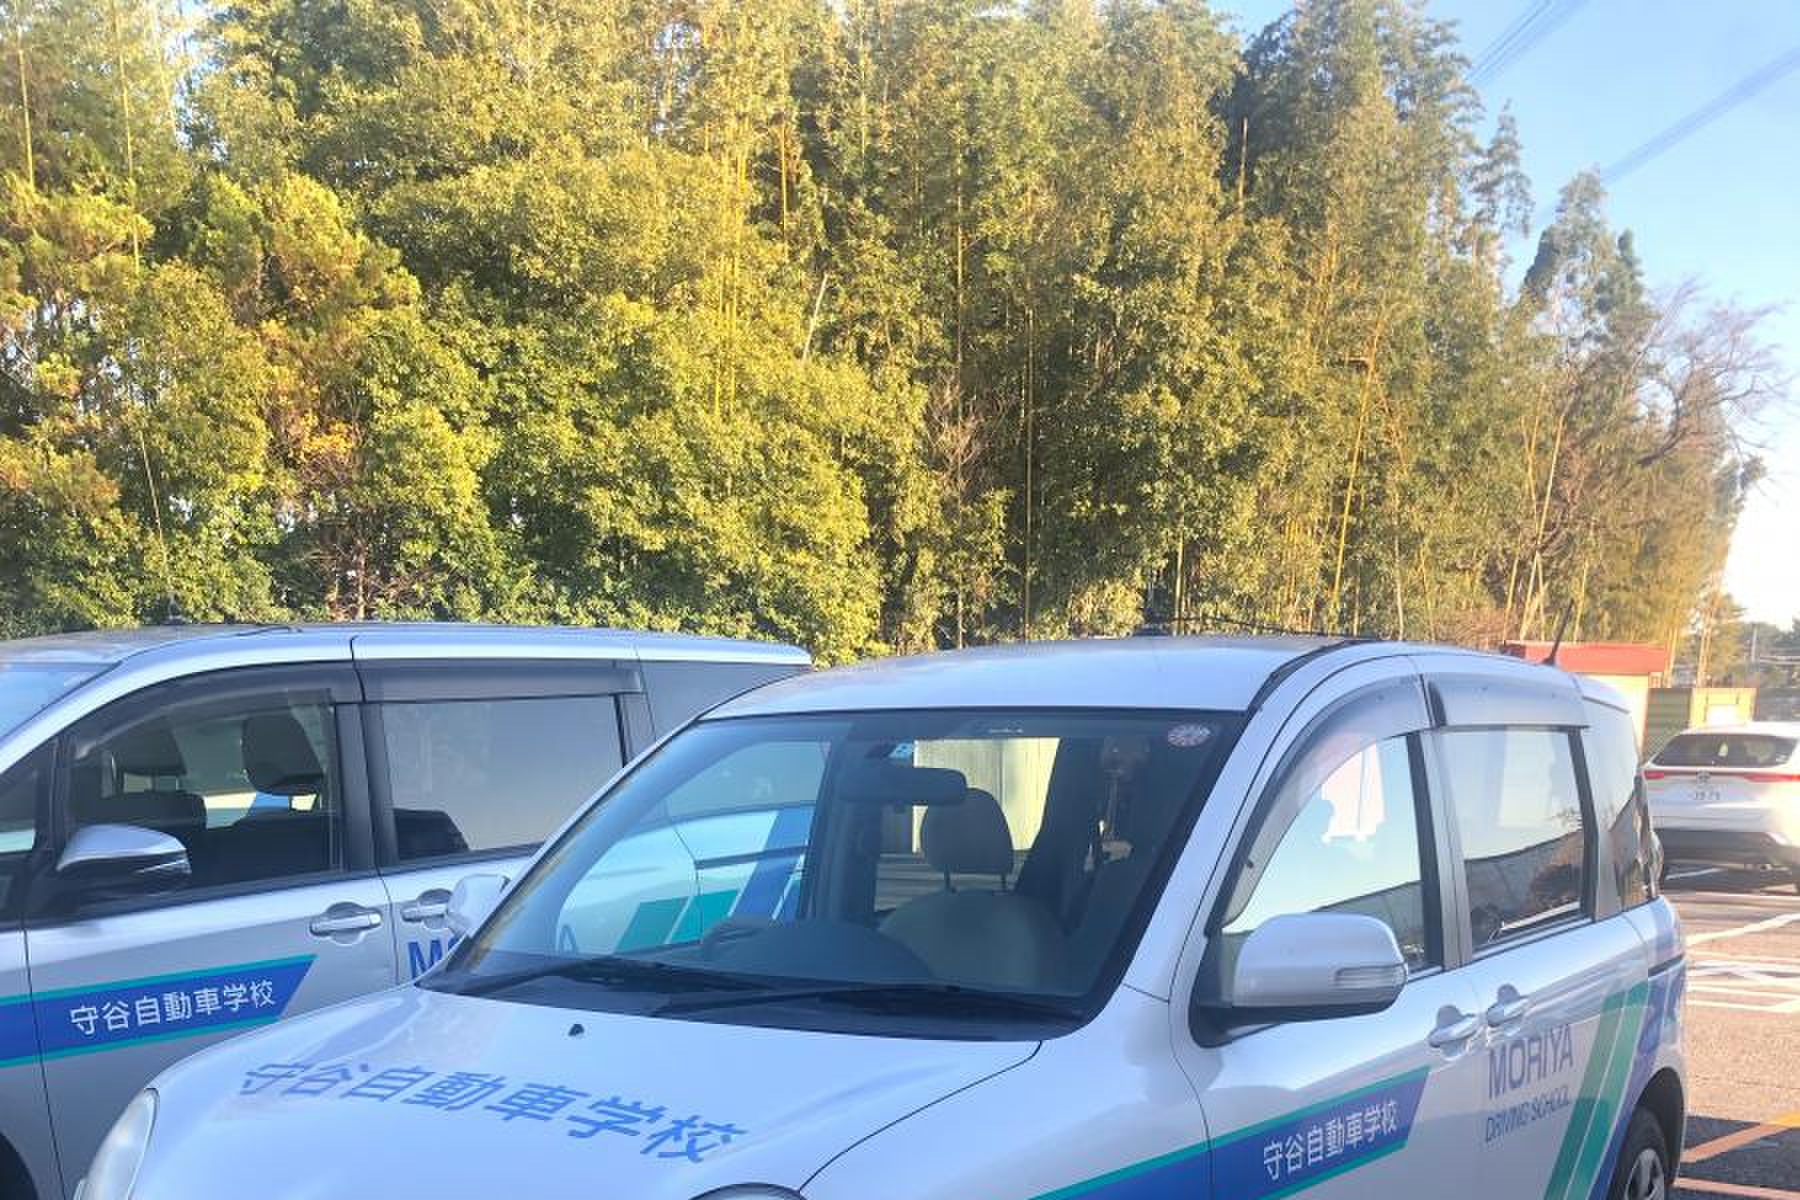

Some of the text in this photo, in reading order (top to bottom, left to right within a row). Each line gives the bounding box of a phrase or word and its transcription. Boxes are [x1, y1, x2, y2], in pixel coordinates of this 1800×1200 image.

[408, 937, 459, 980] M
[70, 981, 275, 1036] 守谷自動車学校
[1488, 1025, 1573, 1100] MORIYA
[239, 1064, 748, 1163] 守谷自動車学校
[1263, 1099, 1398, 1180] 守谷自動車学校
